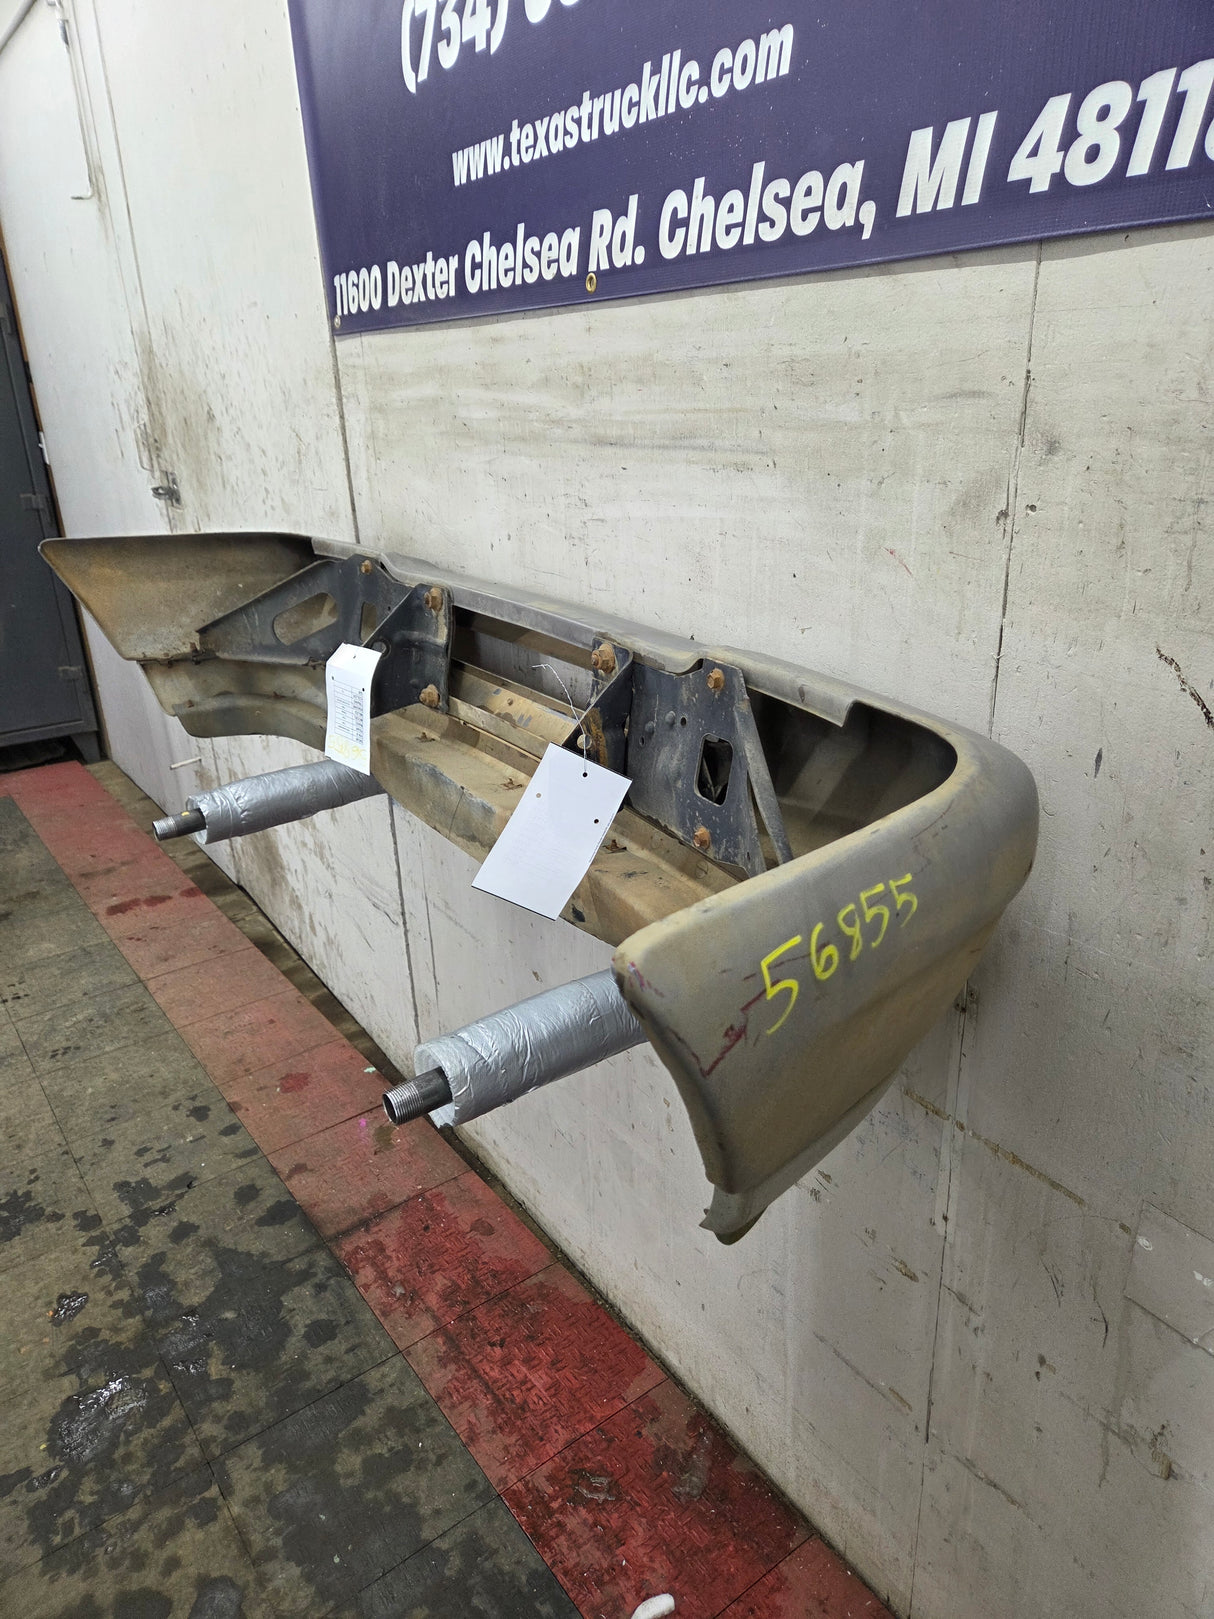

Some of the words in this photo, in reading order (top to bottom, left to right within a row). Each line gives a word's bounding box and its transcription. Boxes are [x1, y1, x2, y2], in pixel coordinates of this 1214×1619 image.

[452, 24, 794, 186] www.texastruckllc.com
[333, 265, 382, 316] 11600
[387, 252, 458, 307] Dexter
[465, 223, 580, 293] Chelsea
[588, 194, 645, 272] Rd.
[659, 160, 876, 259] Chelsea,
[896, 111, 998, 217] MI
[1007, 58, 1214, 194] 4811
[760, 873, 918, 1035] 56855
